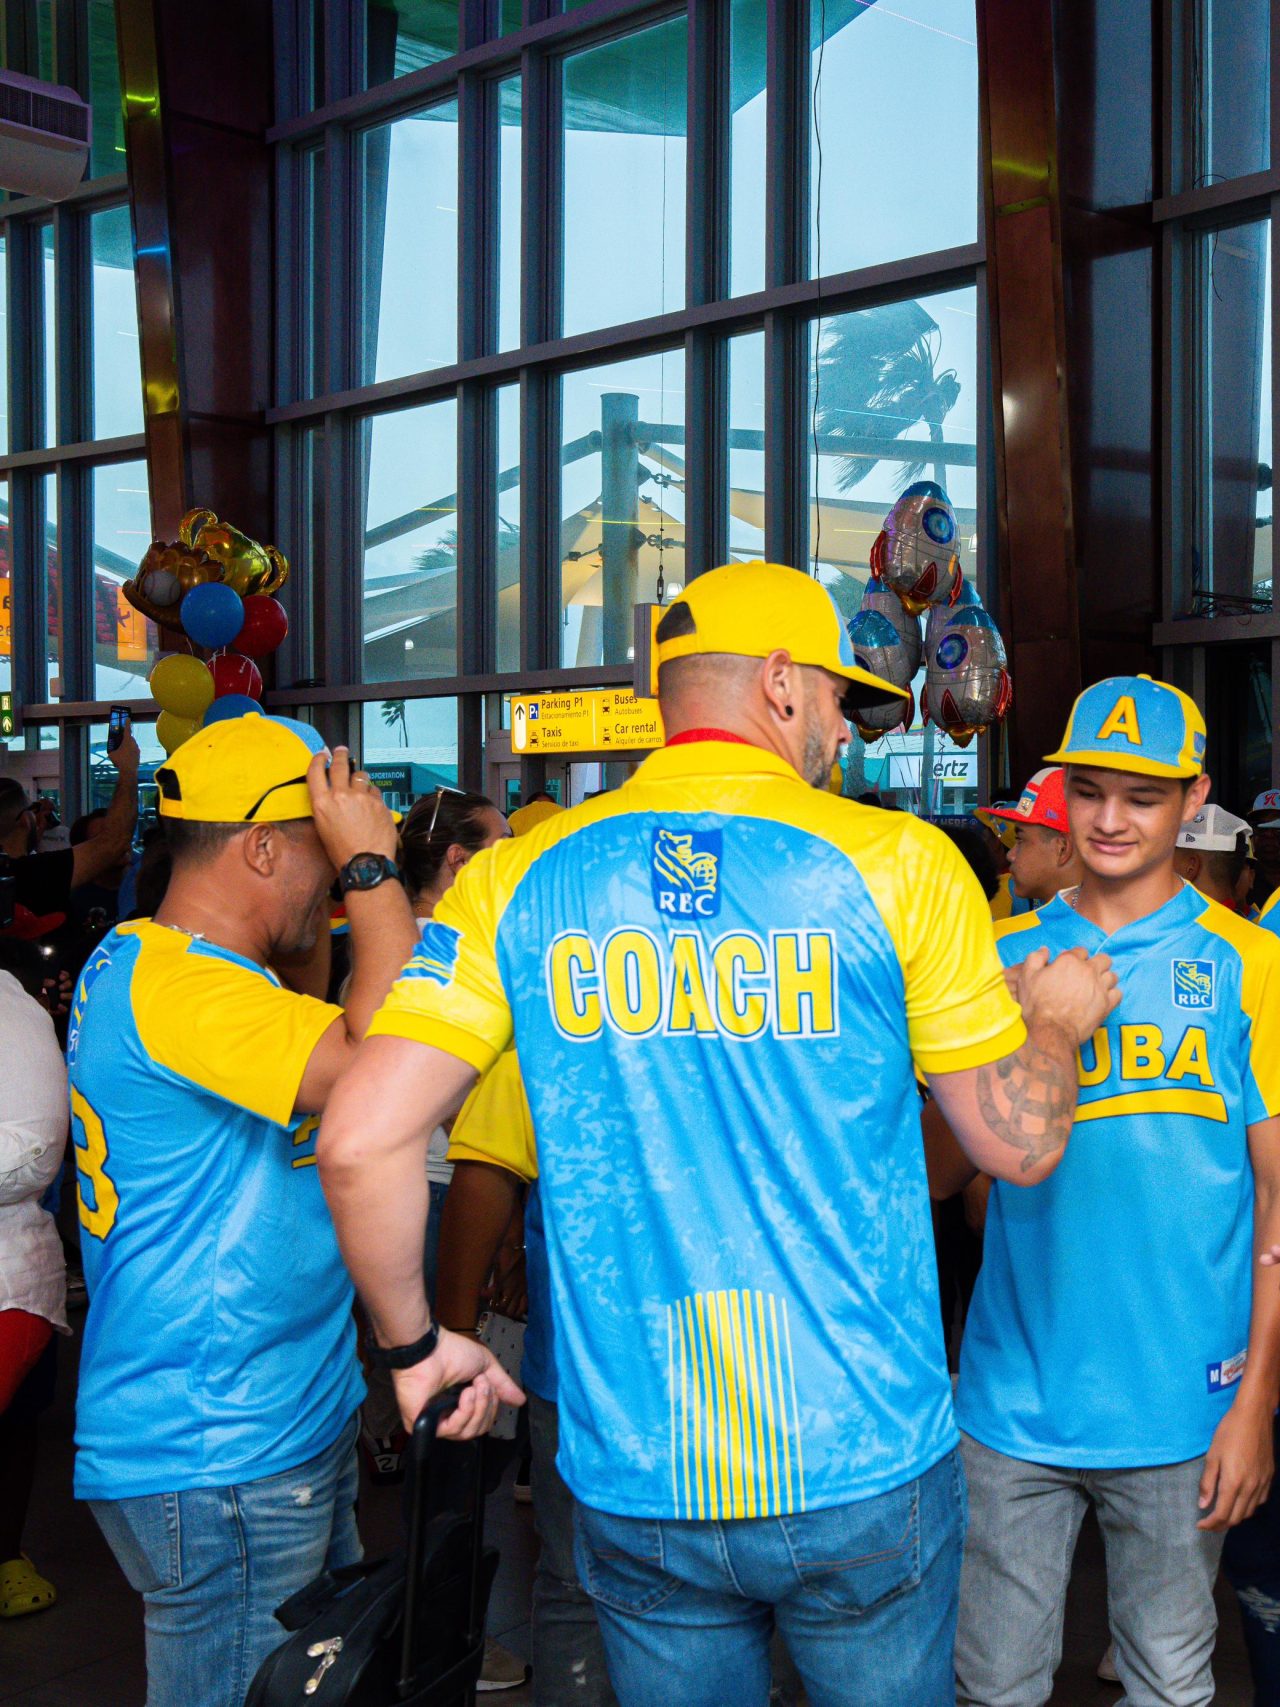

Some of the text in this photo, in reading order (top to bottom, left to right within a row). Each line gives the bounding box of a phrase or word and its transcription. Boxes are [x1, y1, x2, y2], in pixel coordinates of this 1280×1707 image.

[541, 696, 583, 710] Parking P1
[614, 694, 638, 705] Buses
[614, 721, 657, 735] Car rental
[1095, 695, 1143, 746] A
[542, 726, 562, 737] Taxis
[933, 759, 969, 777] ertz
[659, 891, 714, 916] RBC
[545, 925, 841, 1043] COACH
[1178, 992, 1210, 1007] RBC
[1076, 1022, 1216, 1088] UBA
[1209, 1368, 1220, 1384] M
